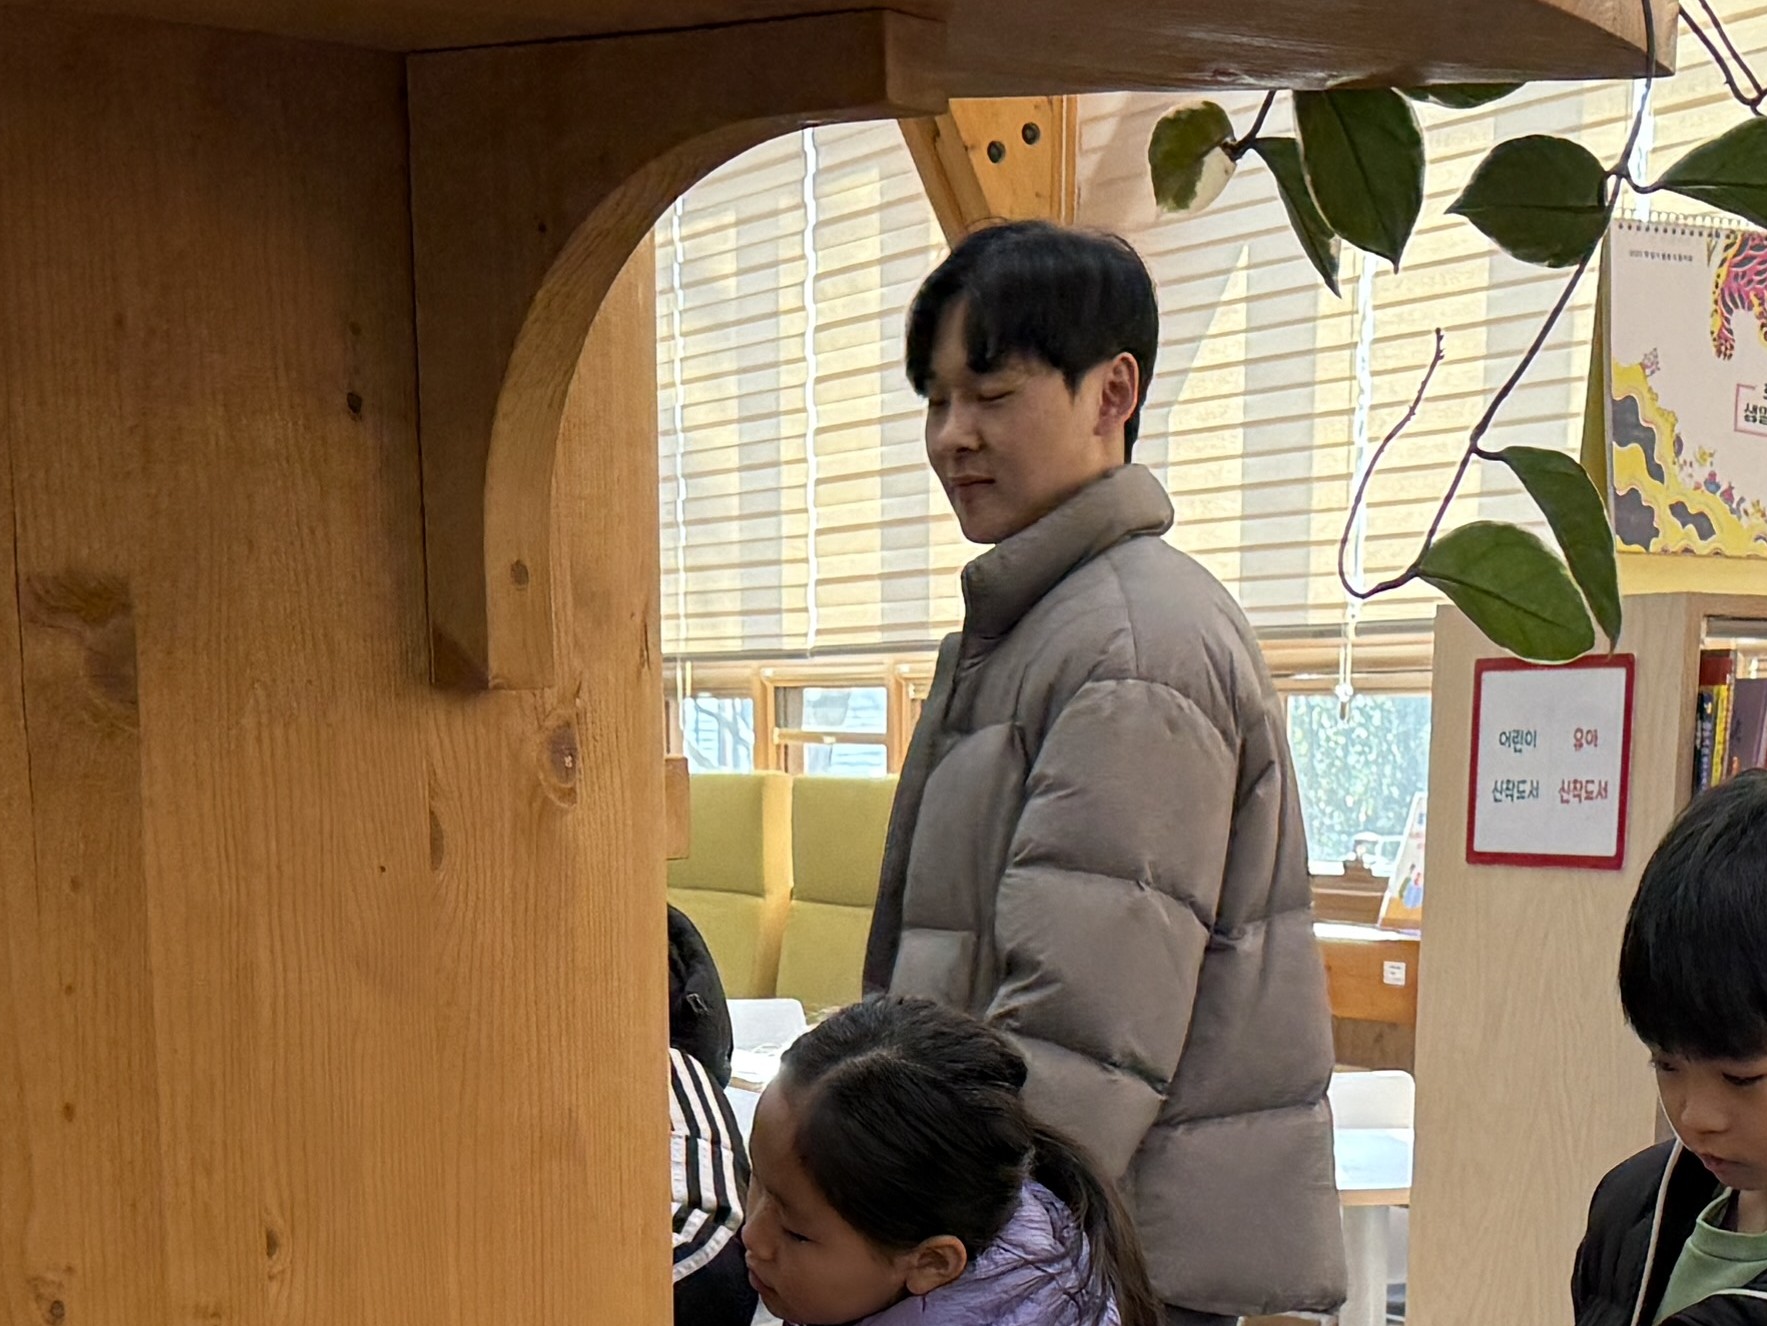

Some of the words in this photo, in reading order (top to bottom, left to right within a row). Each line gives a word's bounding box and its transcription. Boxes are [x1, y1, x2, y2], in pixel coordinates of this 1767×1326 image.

[1498, 729, 1537, 753] 어린이
[1492, 779, 1540, 803] 신착도서
[1558, 778, 1608, 804] 신착도서
